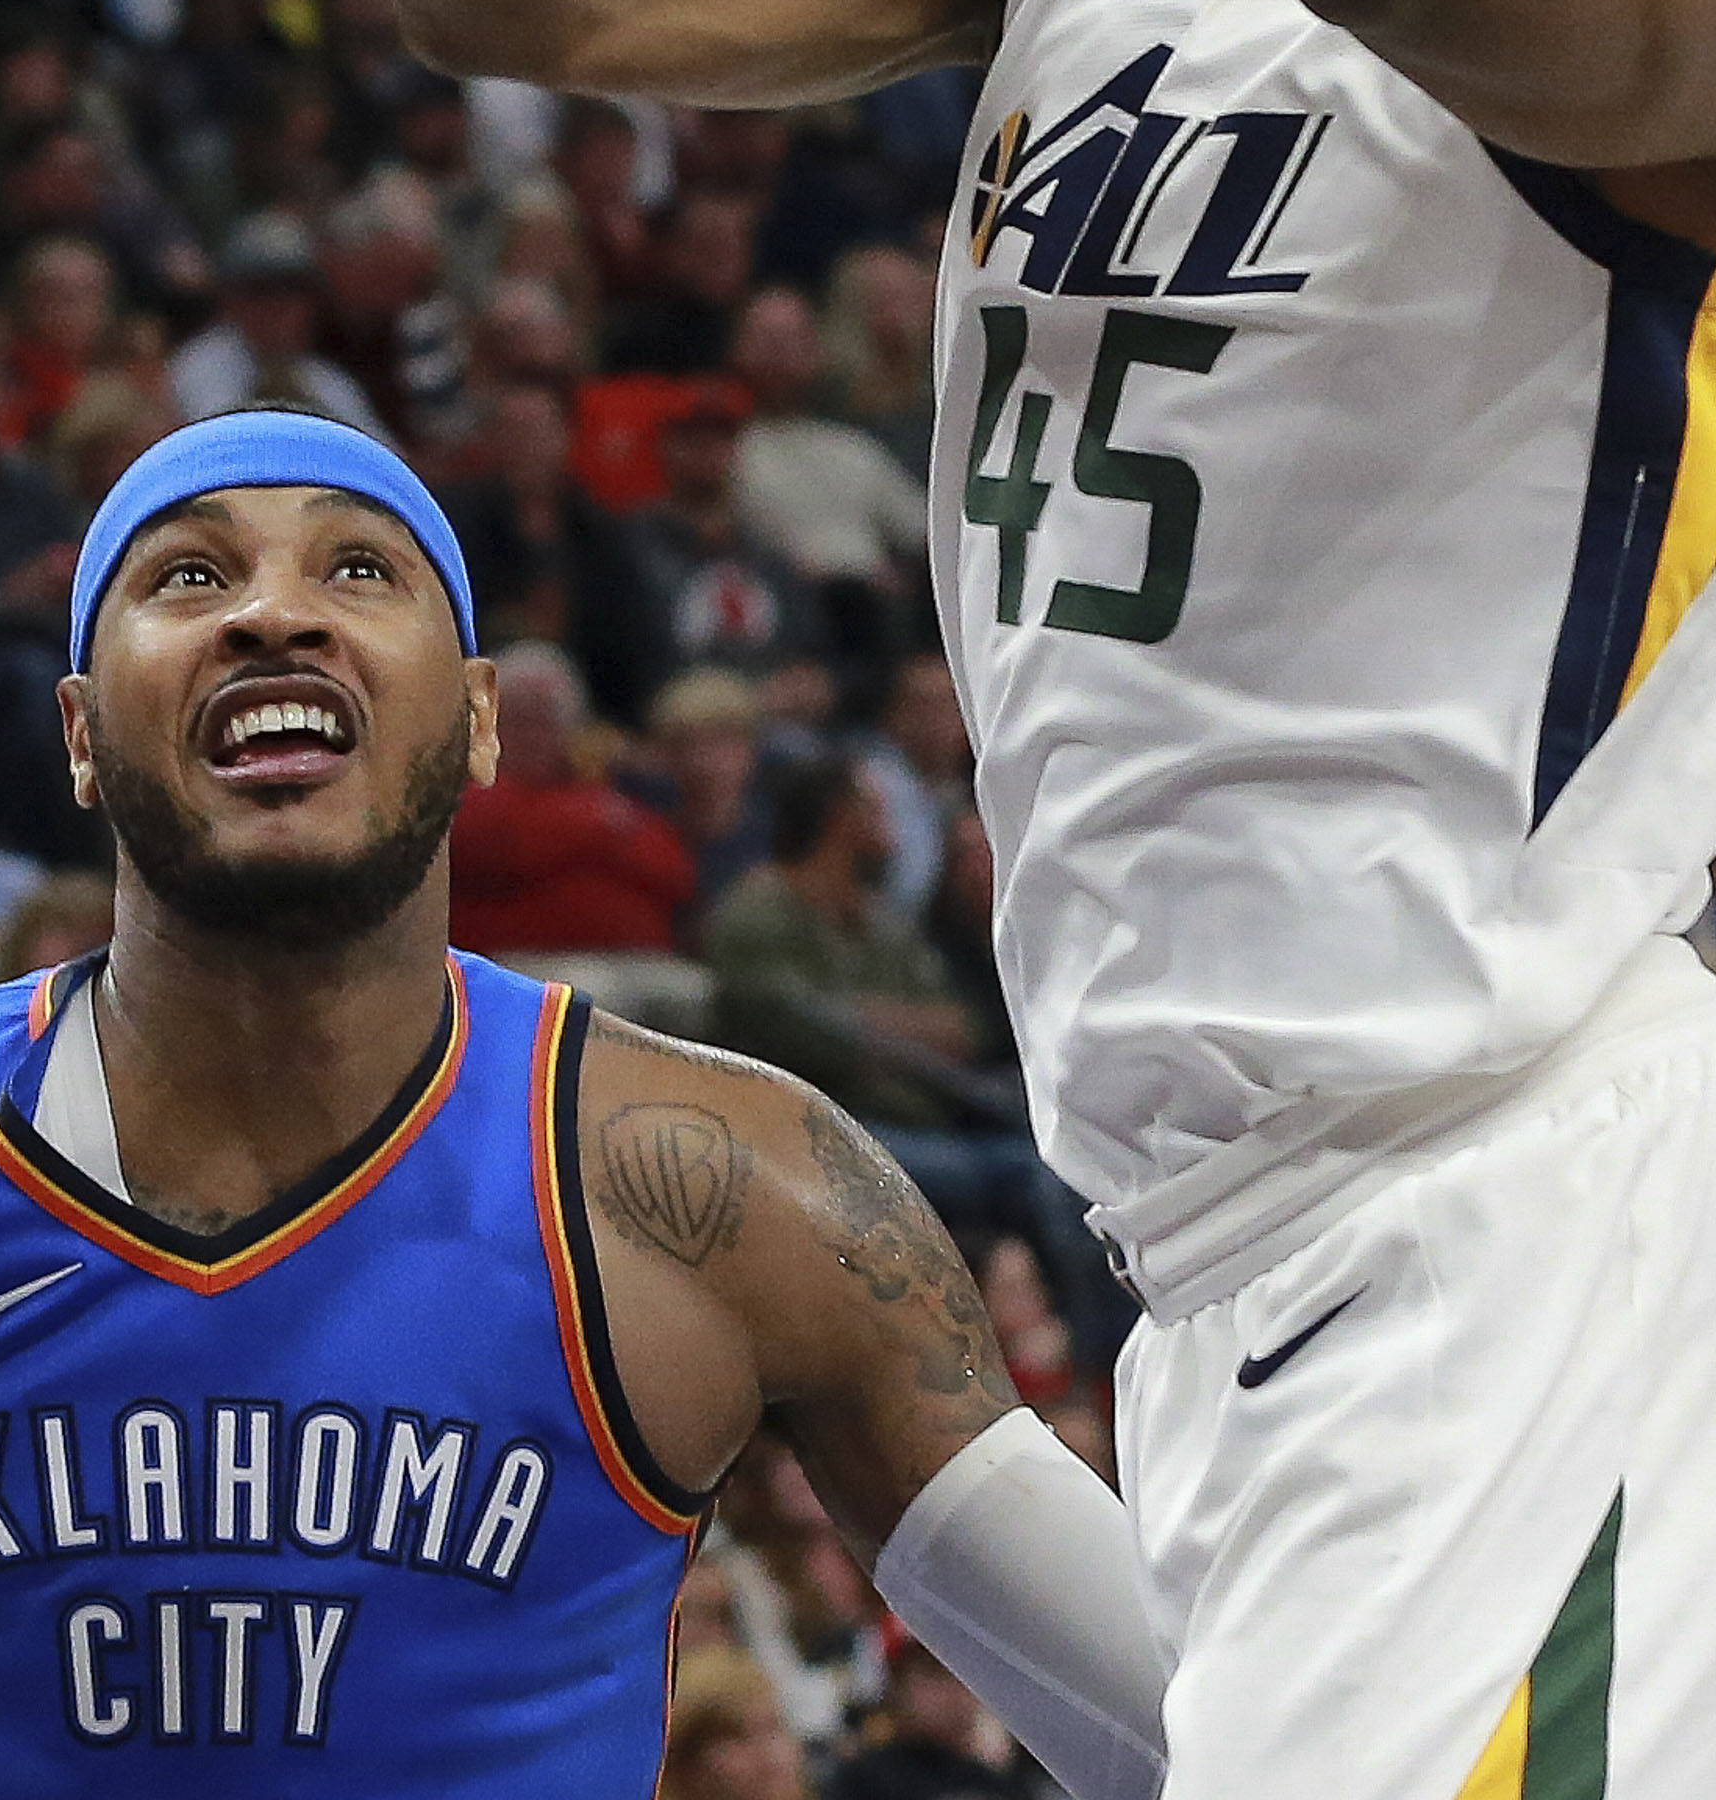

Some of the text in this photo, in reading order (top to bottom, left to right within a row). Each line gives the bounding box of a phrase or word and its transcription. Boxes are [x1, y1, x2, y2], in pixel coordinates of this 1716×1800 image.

[966, 305, 1236, 644] 45
[614, 1121, 719, 1243] WB
[64, 1599, 349, 1738] CITY
